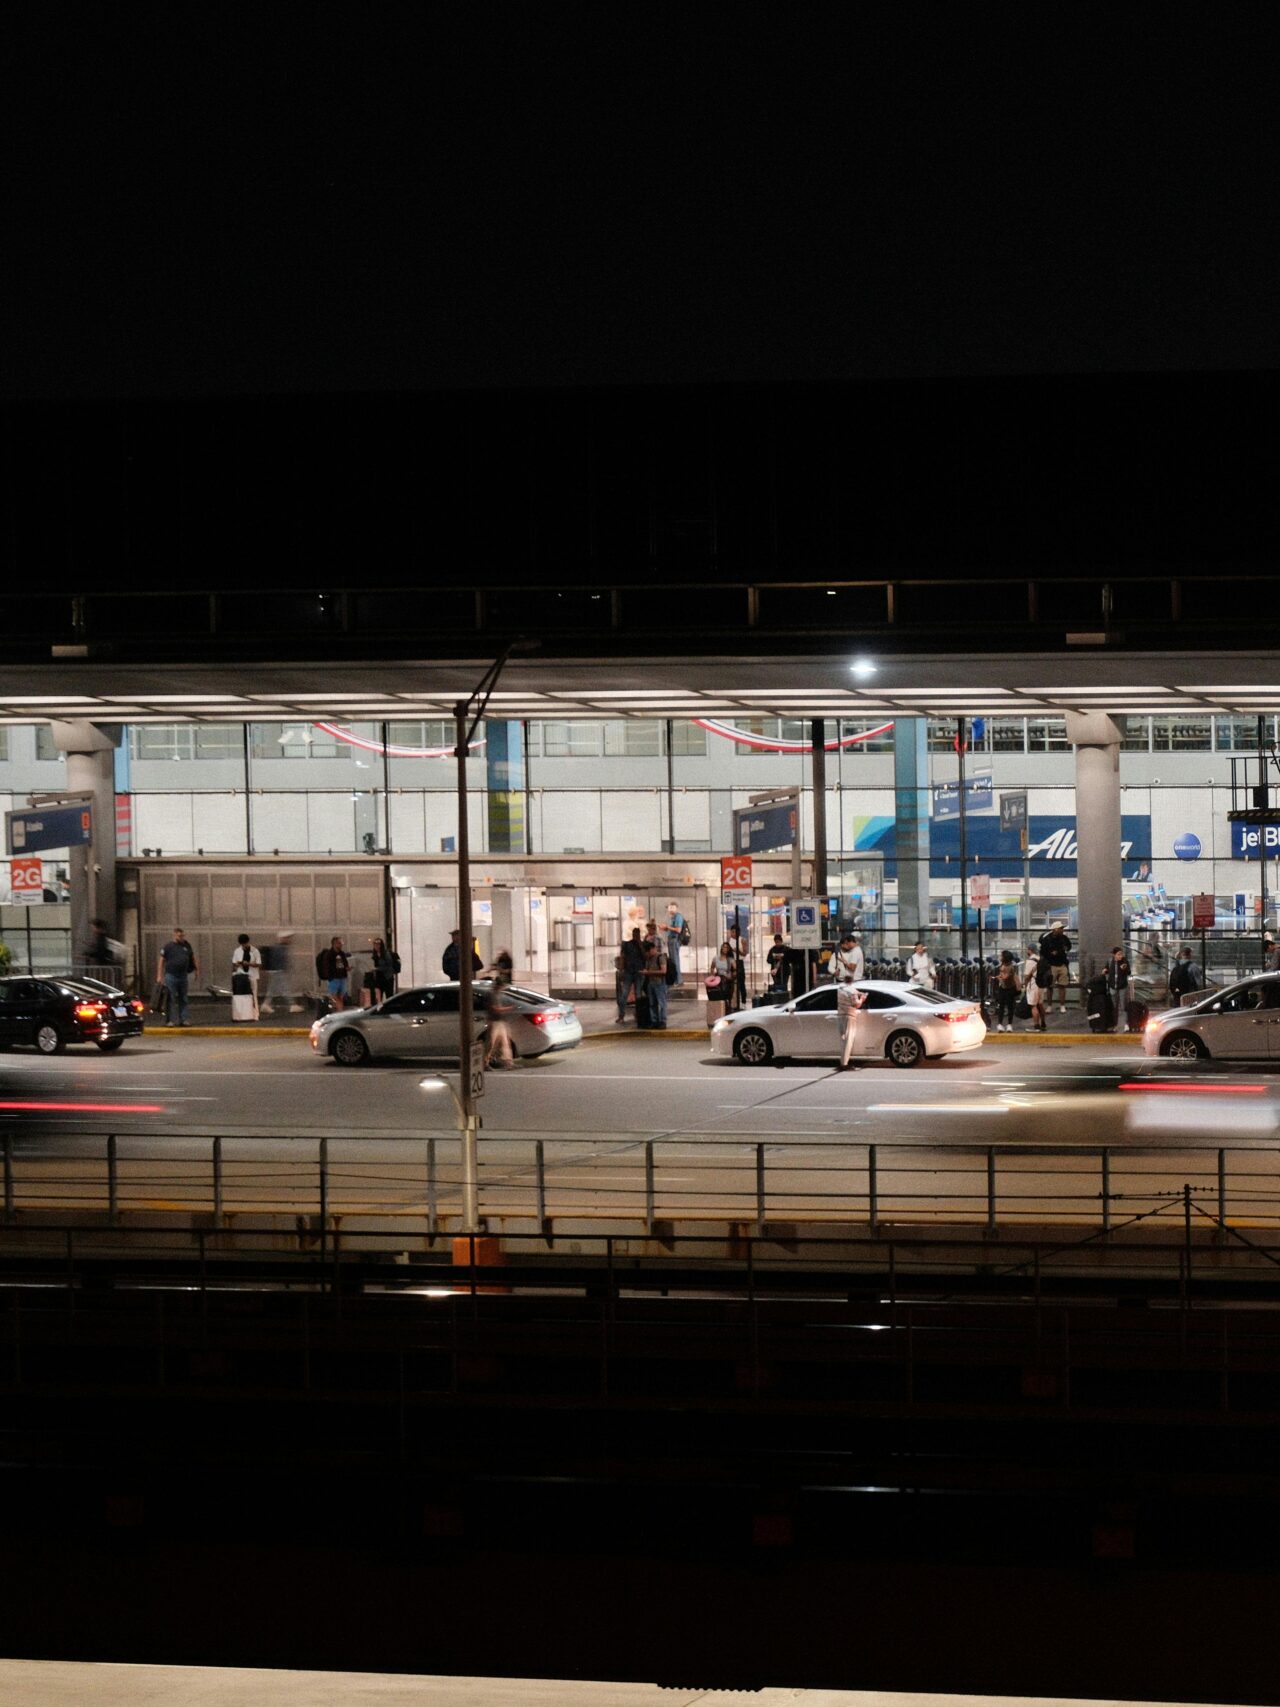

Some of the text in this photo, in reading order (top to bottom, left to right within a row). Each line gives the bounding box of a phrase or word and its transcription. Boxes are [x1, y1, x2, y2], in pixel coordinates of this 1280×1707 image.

[1022, 828, 1133, 859] Ala
[13, 867, 41, 887] 2G
[724, 866, 751, 886] 2G
[472, 1071, 483, 1093] 20
